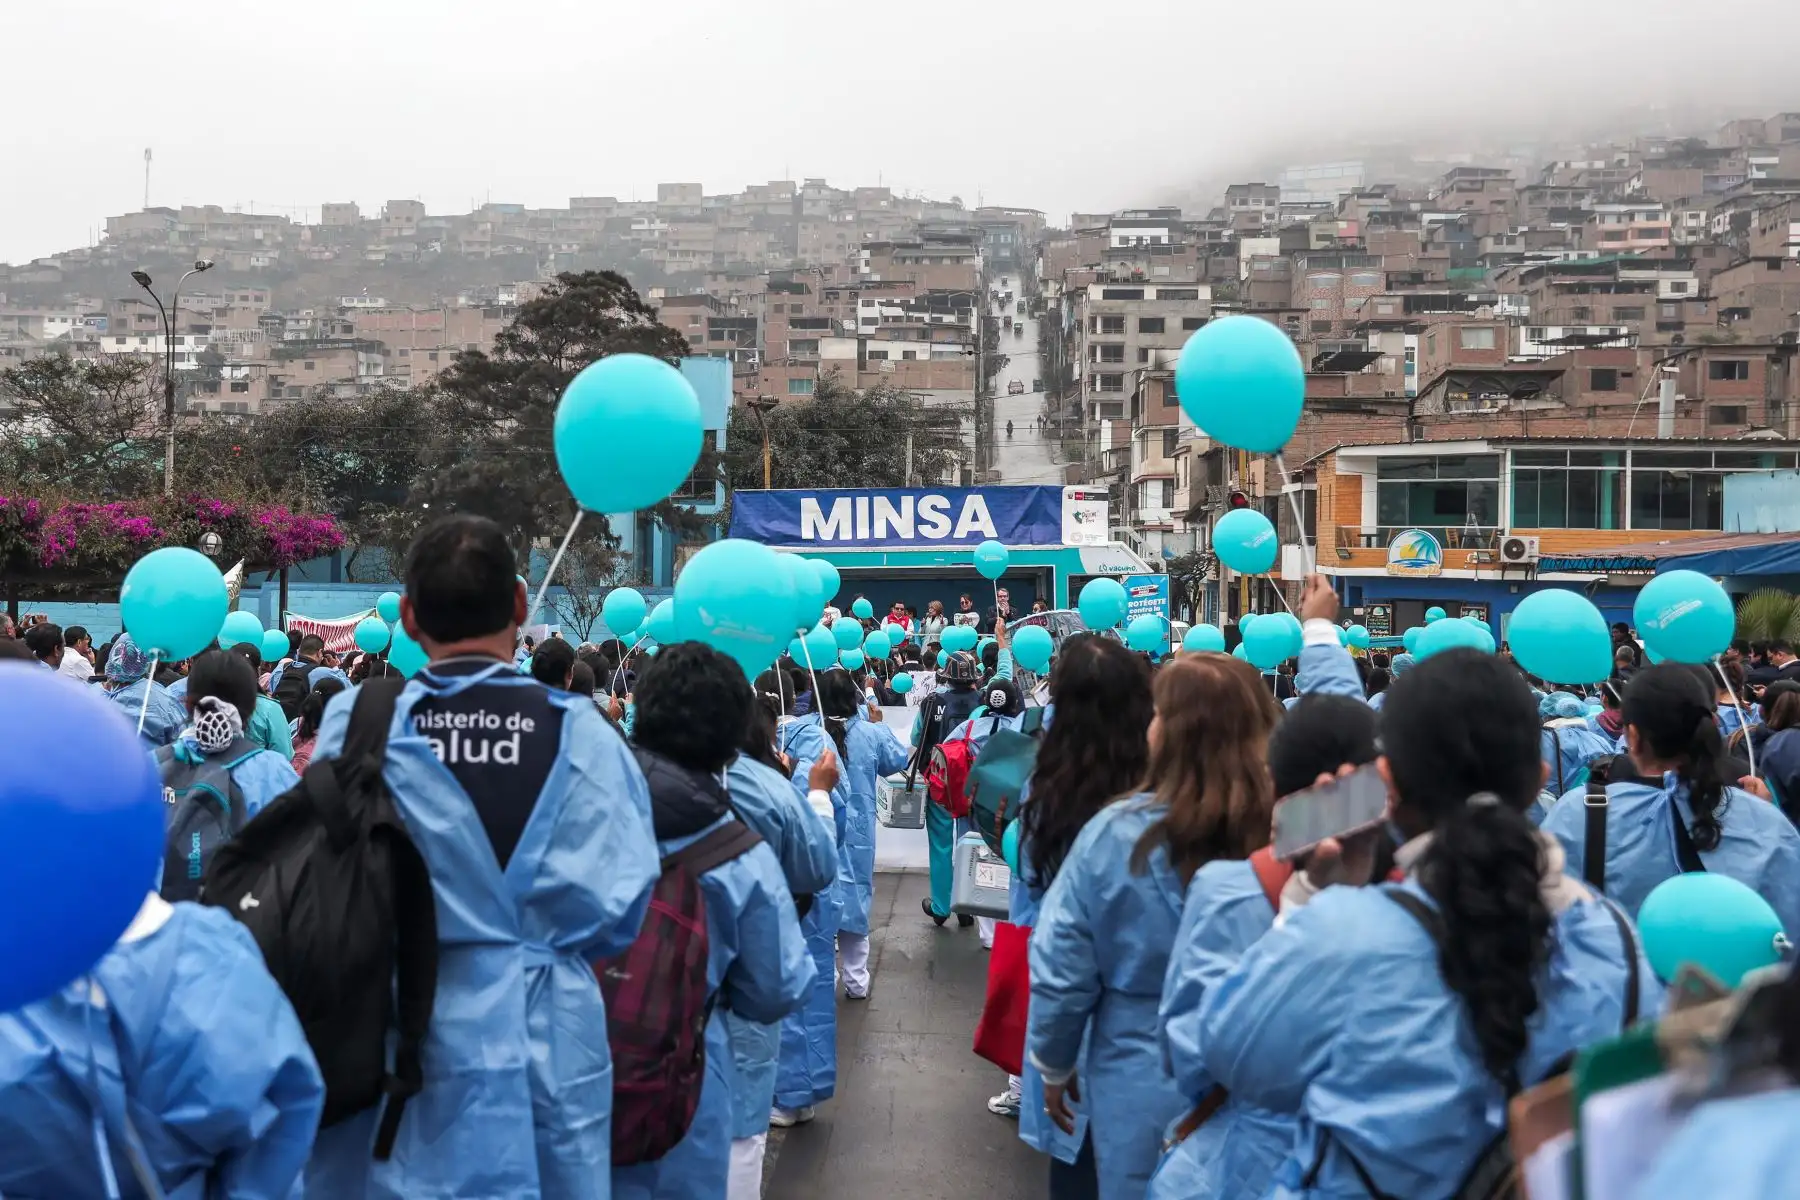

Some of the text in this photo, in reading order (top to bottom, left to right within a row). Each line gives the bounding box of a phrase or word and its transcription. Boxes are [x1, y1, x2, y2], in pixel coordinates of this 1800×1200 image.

[800, 494, 998, 541] MINSA
[1129, 606, 1153, 614] contra
[505, 711, 536, 732] de
[188, 831, 201, 879] Wilson
